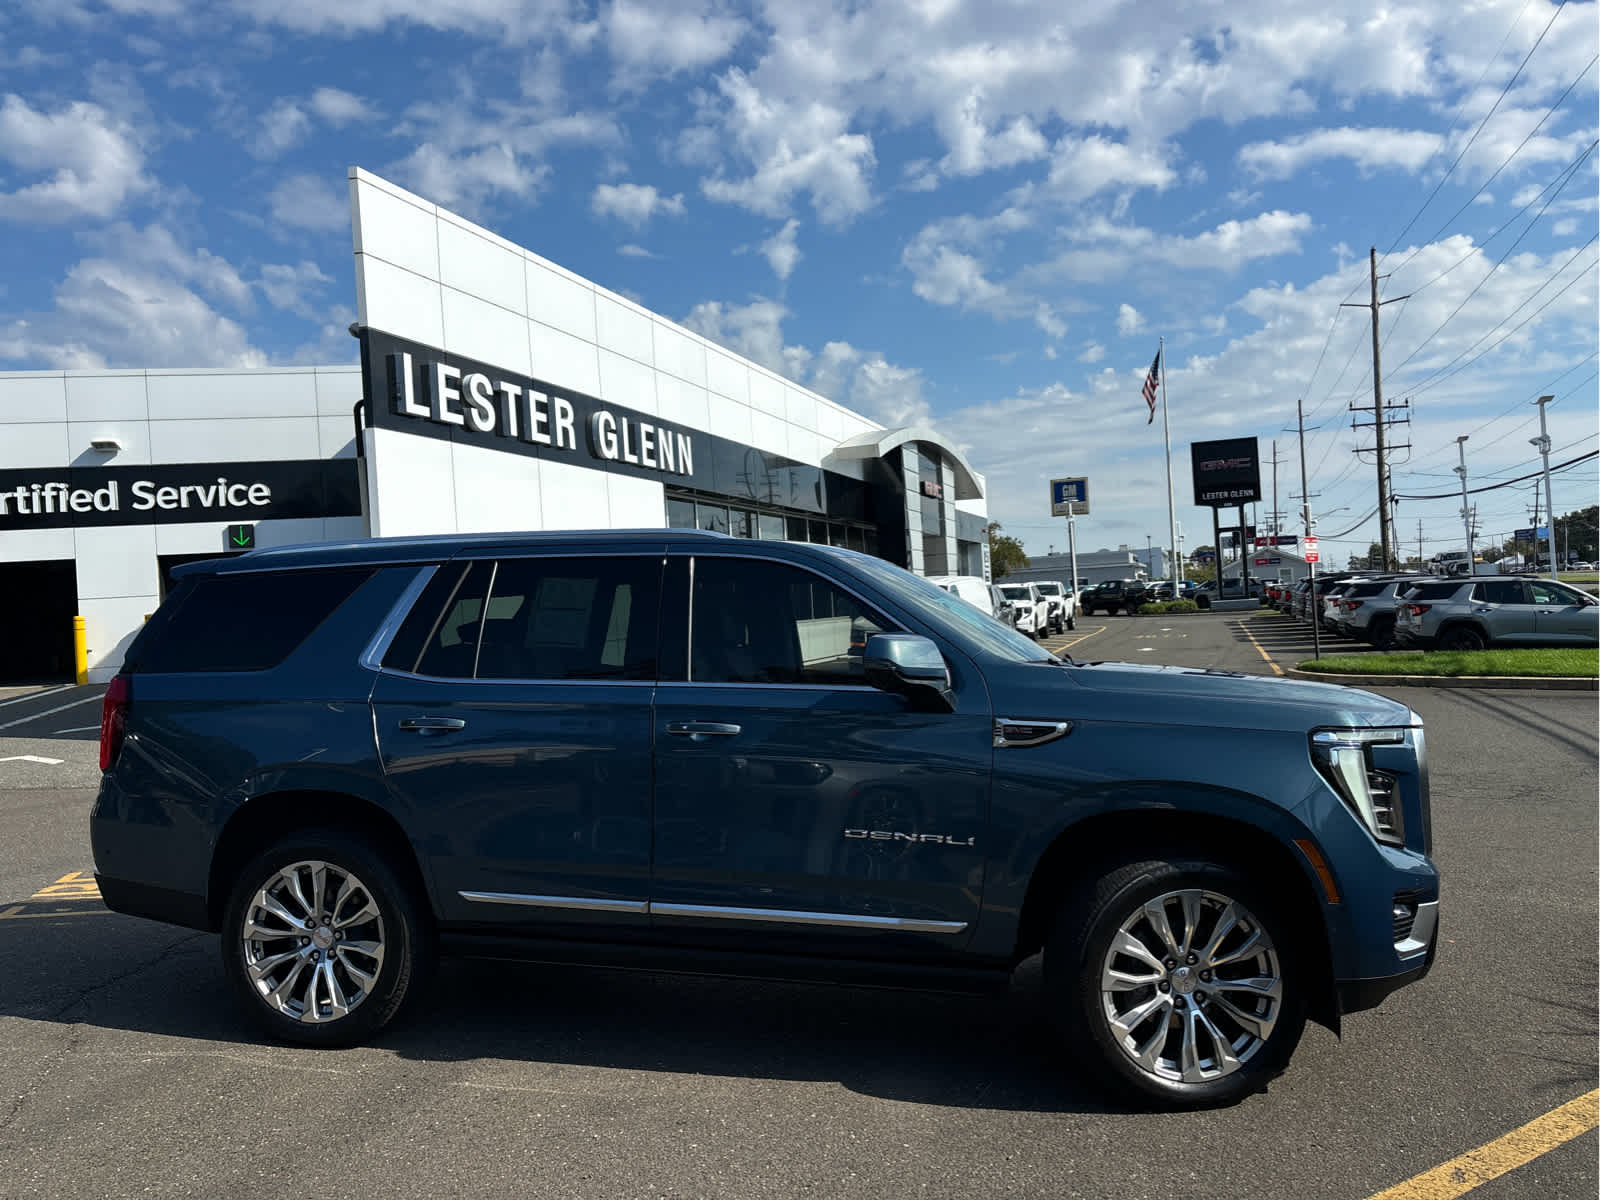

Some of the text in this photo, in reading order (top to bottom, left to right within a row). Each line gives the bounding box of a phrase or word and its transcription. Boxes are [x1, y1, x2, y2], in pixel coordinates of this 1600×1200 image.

[399, 352, 694, 476] LESTER GLENN
[131, 477, 272, 511] Service
[1202, 489, 1254, 500] LESTER GLENN
[844, 828, 975, 847] DENALI
